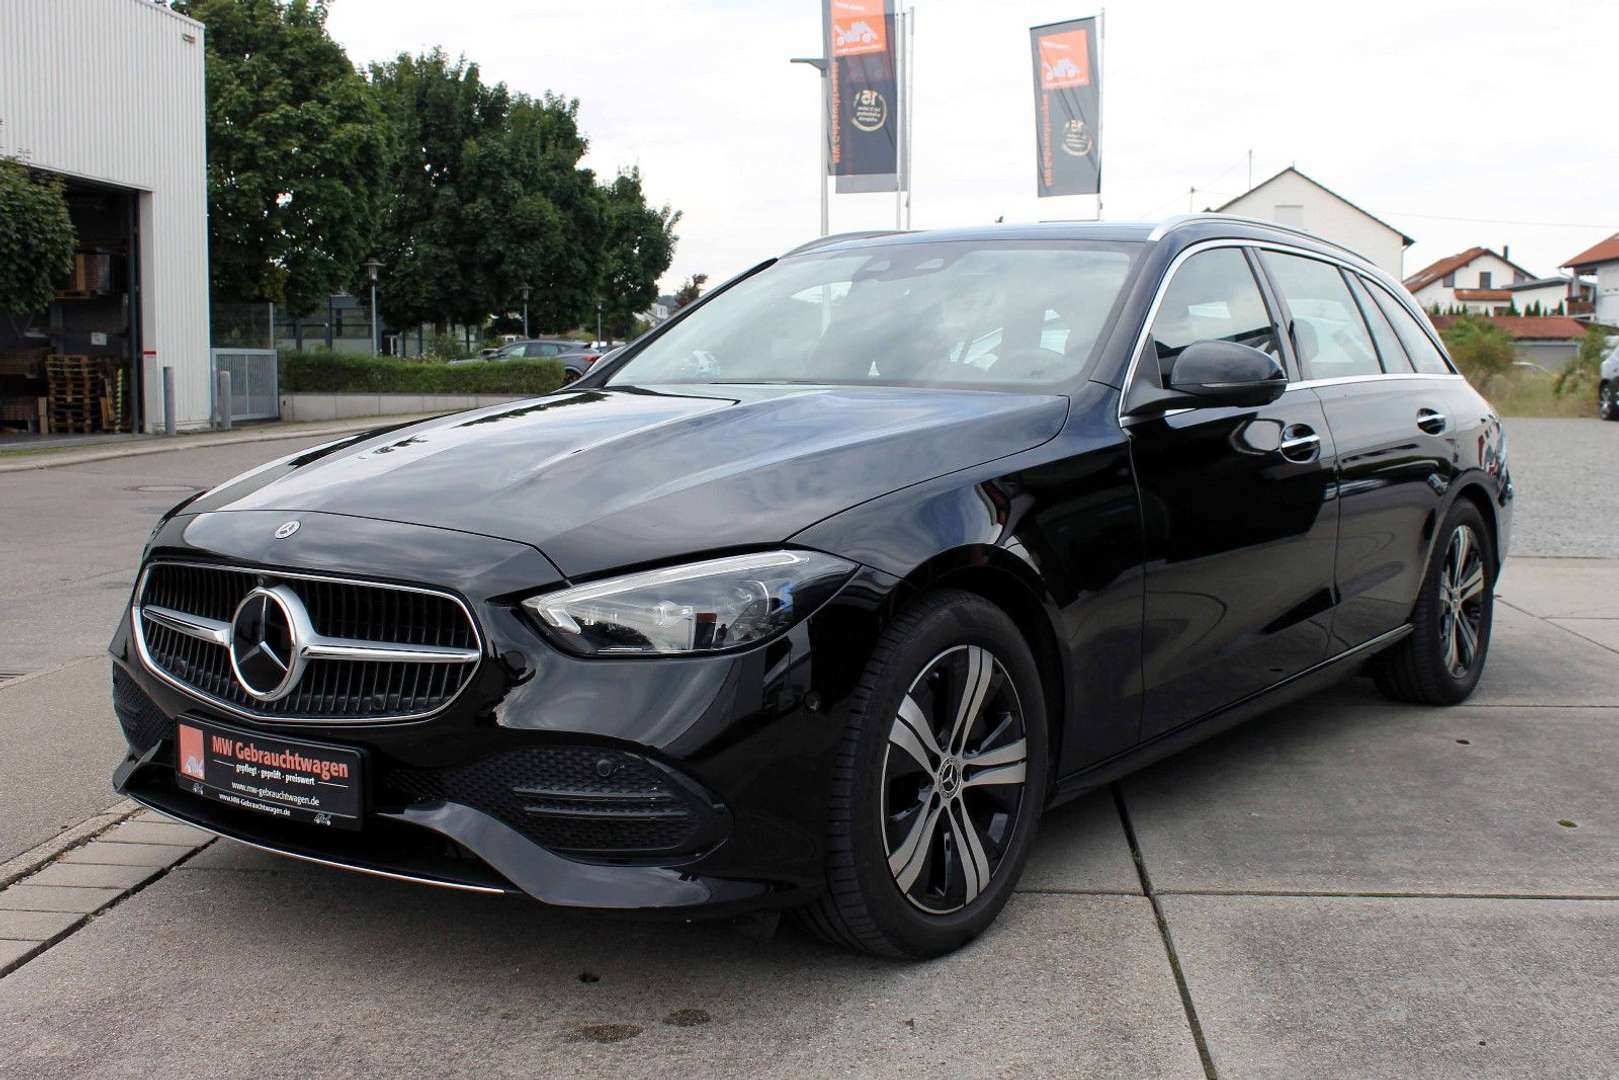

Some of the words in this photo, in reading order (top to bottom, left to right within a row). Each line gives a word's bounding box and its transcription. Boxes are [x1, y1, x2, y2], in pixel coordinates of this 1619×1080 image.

[212, 735, 232, 757] MW
[235, 741, 349, 779] Gebrauchtwagen
[285, 773, 315, 785] preiswert
[231, 781, 320, 806] www.mw-gebrauchtwagen.de
